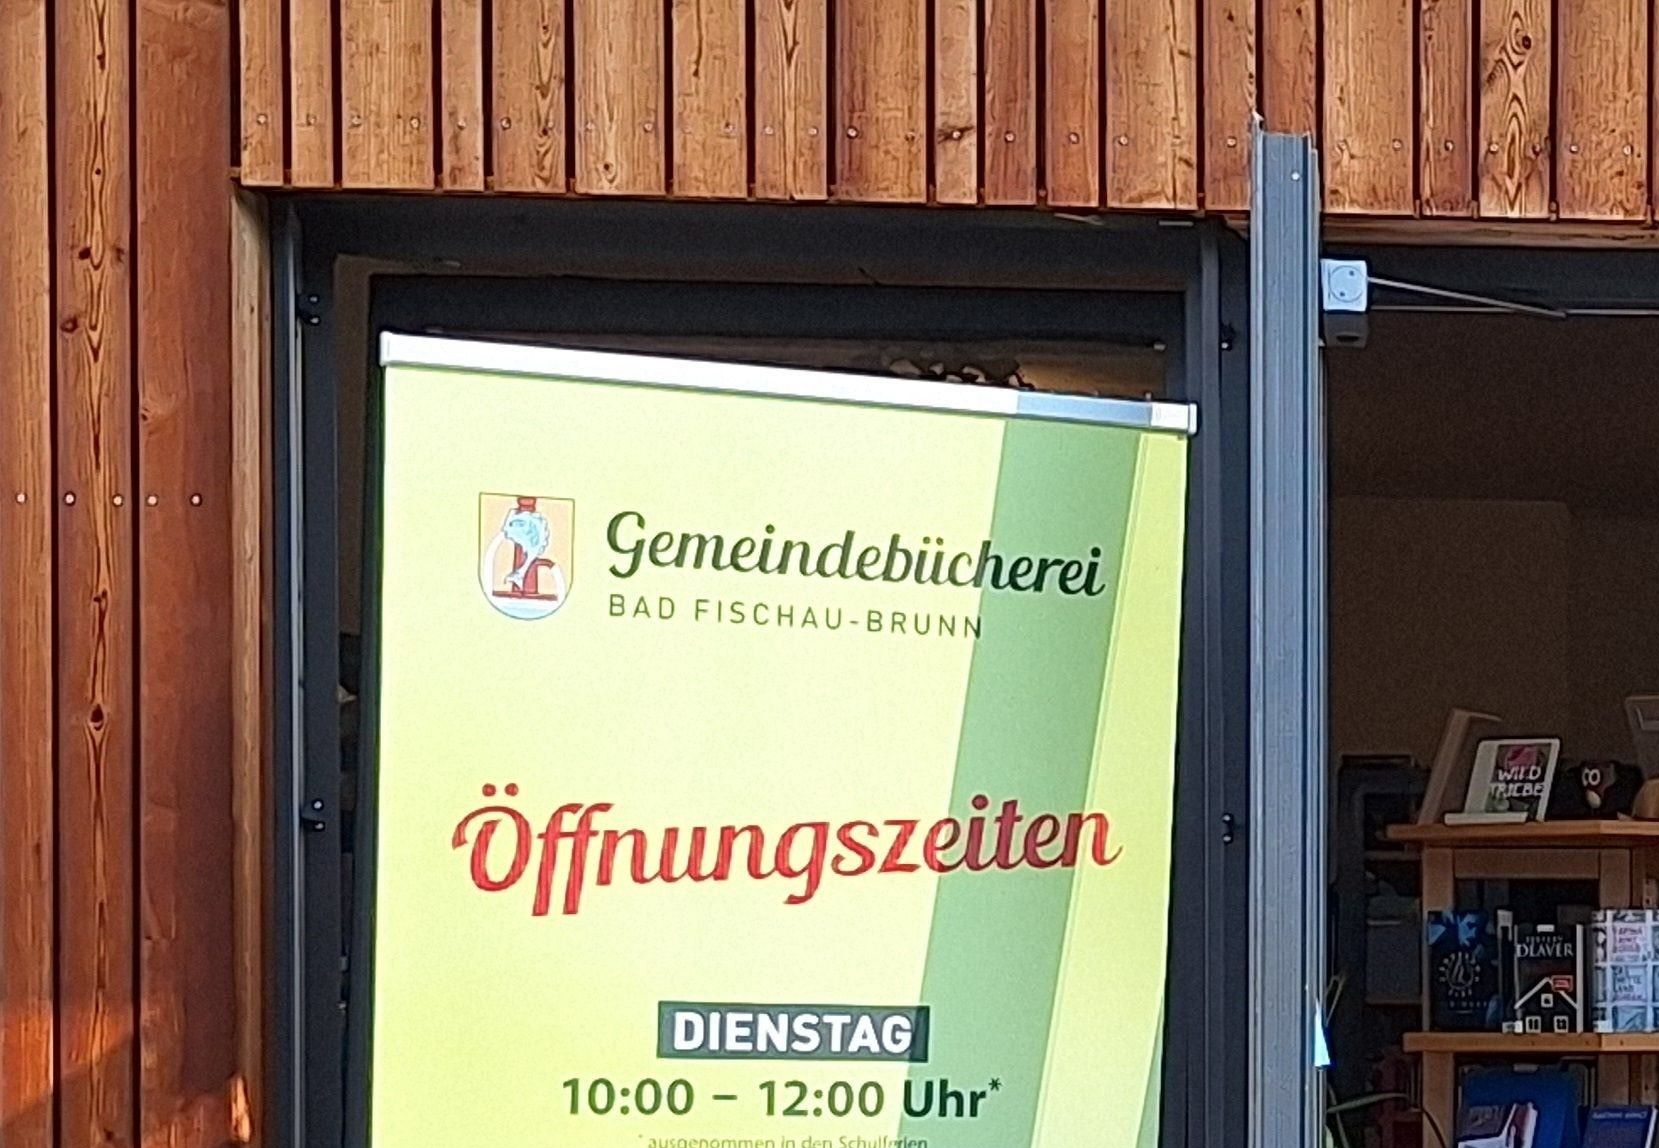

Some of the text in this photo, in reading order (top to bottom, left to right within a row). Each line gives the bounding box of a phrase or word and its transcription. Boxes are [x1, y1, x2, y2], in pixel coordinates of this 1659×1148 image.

[607, 511, 1105, 598] Gemeindebücherei
[610, 594, 982, 640] BAD FISCHAU-BRUNN
[452, 783, 1122, 916] Öffnungszeiten
[674, 1011, 912, 1052] DIENSTAG
[563, 1078, 694, 1115] 10:00
[759, 1080, 884, 1117] 12:00
